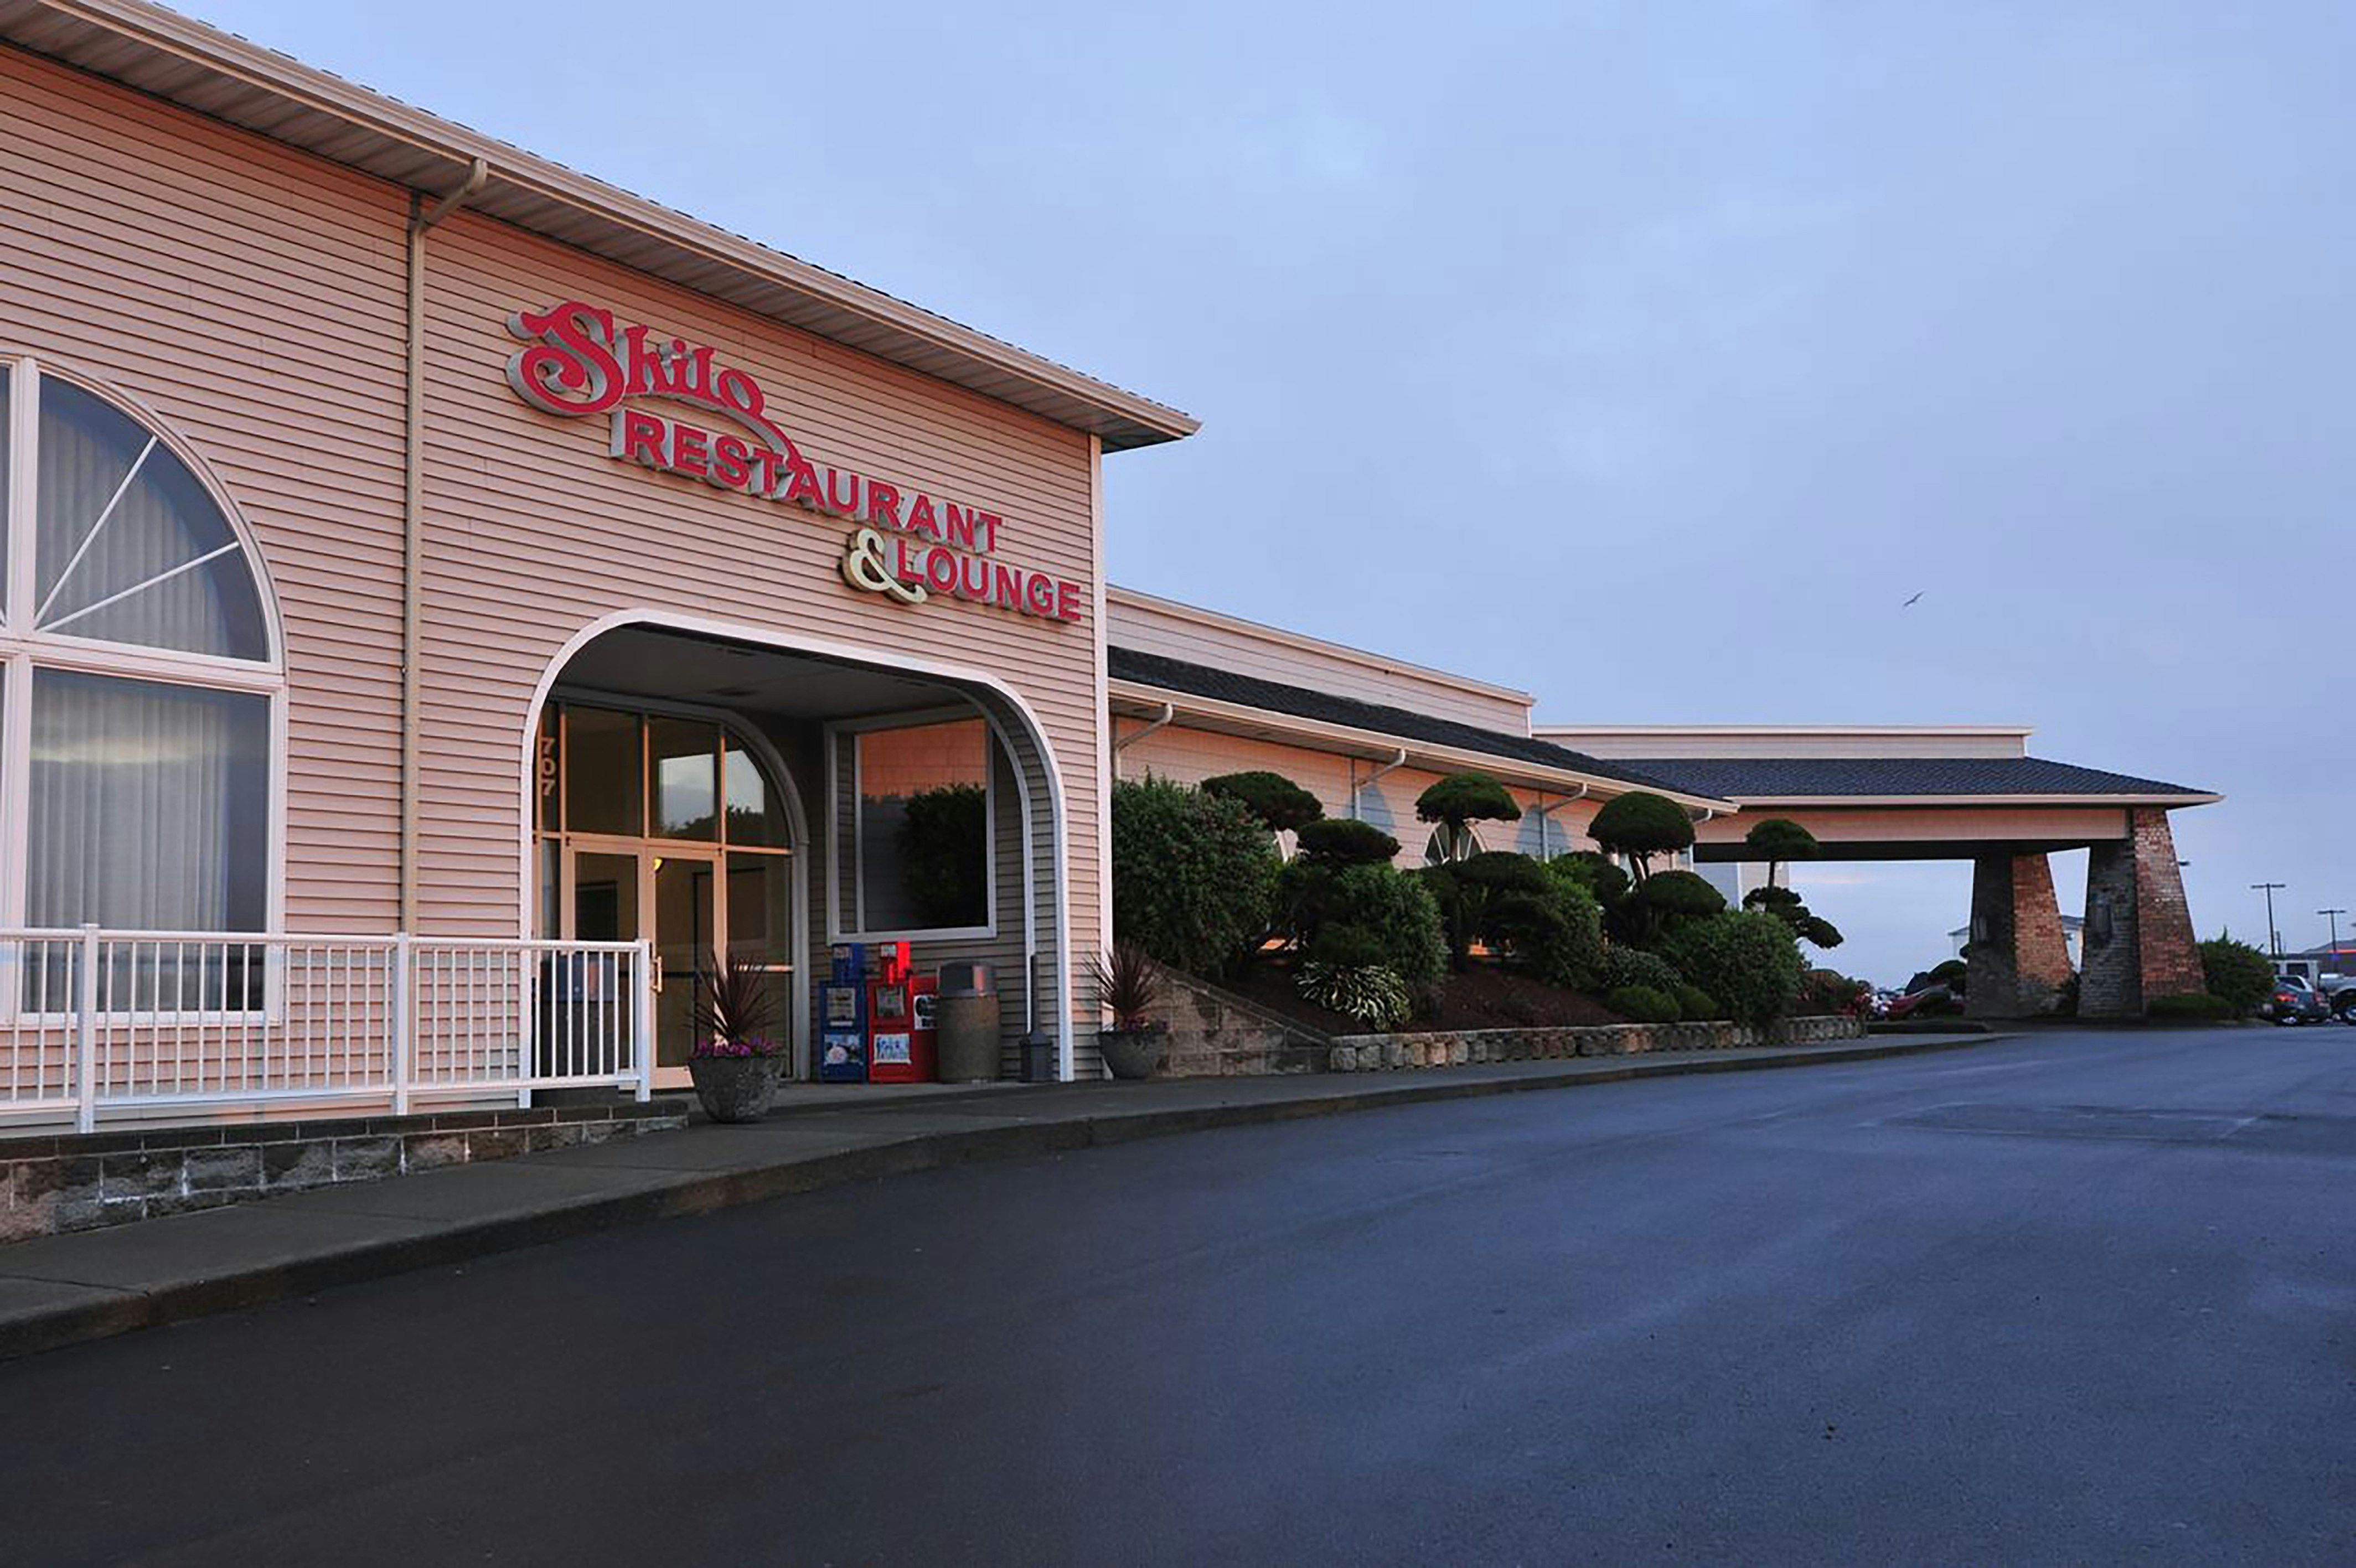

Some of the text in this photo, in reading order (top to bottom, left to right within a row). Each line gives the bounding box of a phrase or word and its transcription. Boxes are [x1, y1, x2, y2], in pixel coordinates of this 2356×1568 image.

[519, 301, 800, 462] Shilo
[623, 409, 1003, 553] RESTAURANT
[848, 528, 1082, 621] & LOUNGE
[541, 736, 556, 796] 707
